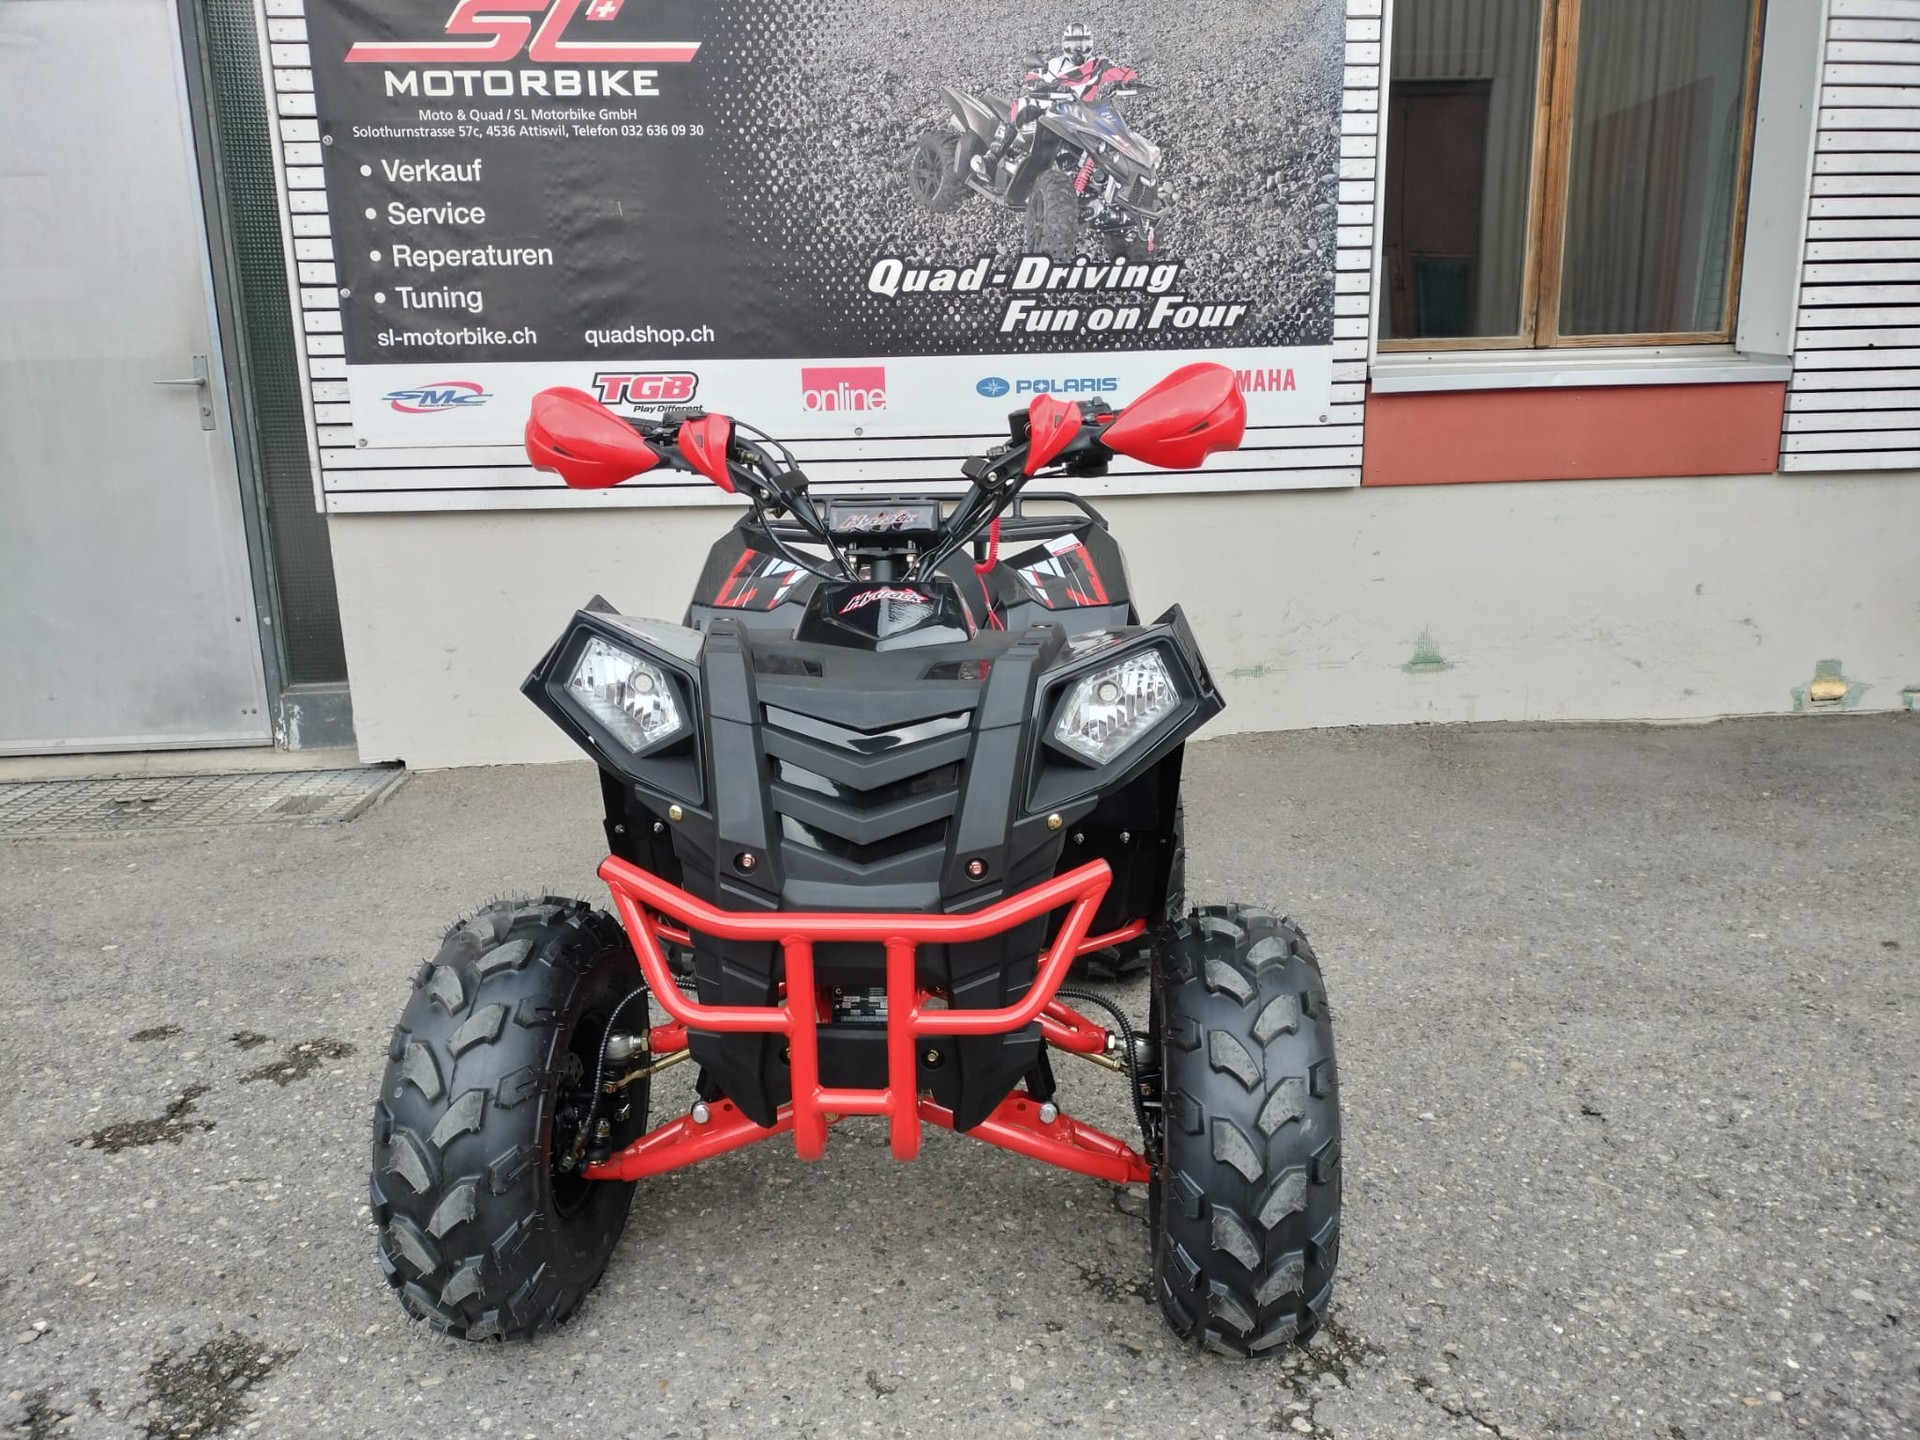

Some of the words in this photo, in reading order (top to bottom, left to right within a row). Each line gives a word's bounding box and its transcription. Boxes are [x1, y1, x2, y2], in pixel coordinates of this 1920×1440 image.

[344, 0, 702, 62] SL
[384, 70, 660, 97] MOTORBIKE
[418, 109, 453, 121] Moto
[457, 109, 466, 121] &
[469, 109, 503, 122] Quad
[506, 109, 512, 121] /
[514, 109, 528, 120] SL
[531, 108, 596, 121] Motorbike
[599, 108, 637, 120] GmbH
[352, 126, 455, 138] Solothurnstrasse
[458, 126, 483, 139] 57c,
[486, 125, 516, 137] 4536
[519, 125, 569, 139] Attiswil,
[572, 125, 618, 137] Telefon
[621, 124, 643, 136] 032
[646, 124, 668, 136] 636
[671, 124, 686, 136] 09
[689, 124, 704, 136] 30
[381, 159, 482, 183] Verkauf
[387, 202, 486, 226] Service
[393, 244, 554, 272] Reperaturen
[867, 256, 991, 298] Quad
[1012, 255, 1178, 294] Driving
[396, 286, 483, 312] Tuning
[1000, 299, 1083, 333] Fun
[1086, 309, 1137, 331] on
[1144, 296, 1247, 329] Four
[377, 327, 537, 346] sl-motorbike.ch
[584, 325, 715, 346] quadshop.ch
[595, 373, 697, 403] TGB
[1016, 378, 1118, 394] POLARIS
[1235, 368, 1296, 392] MAHA
[802, 382, 886, 412] online
[633, 405, 656, 414] Play
